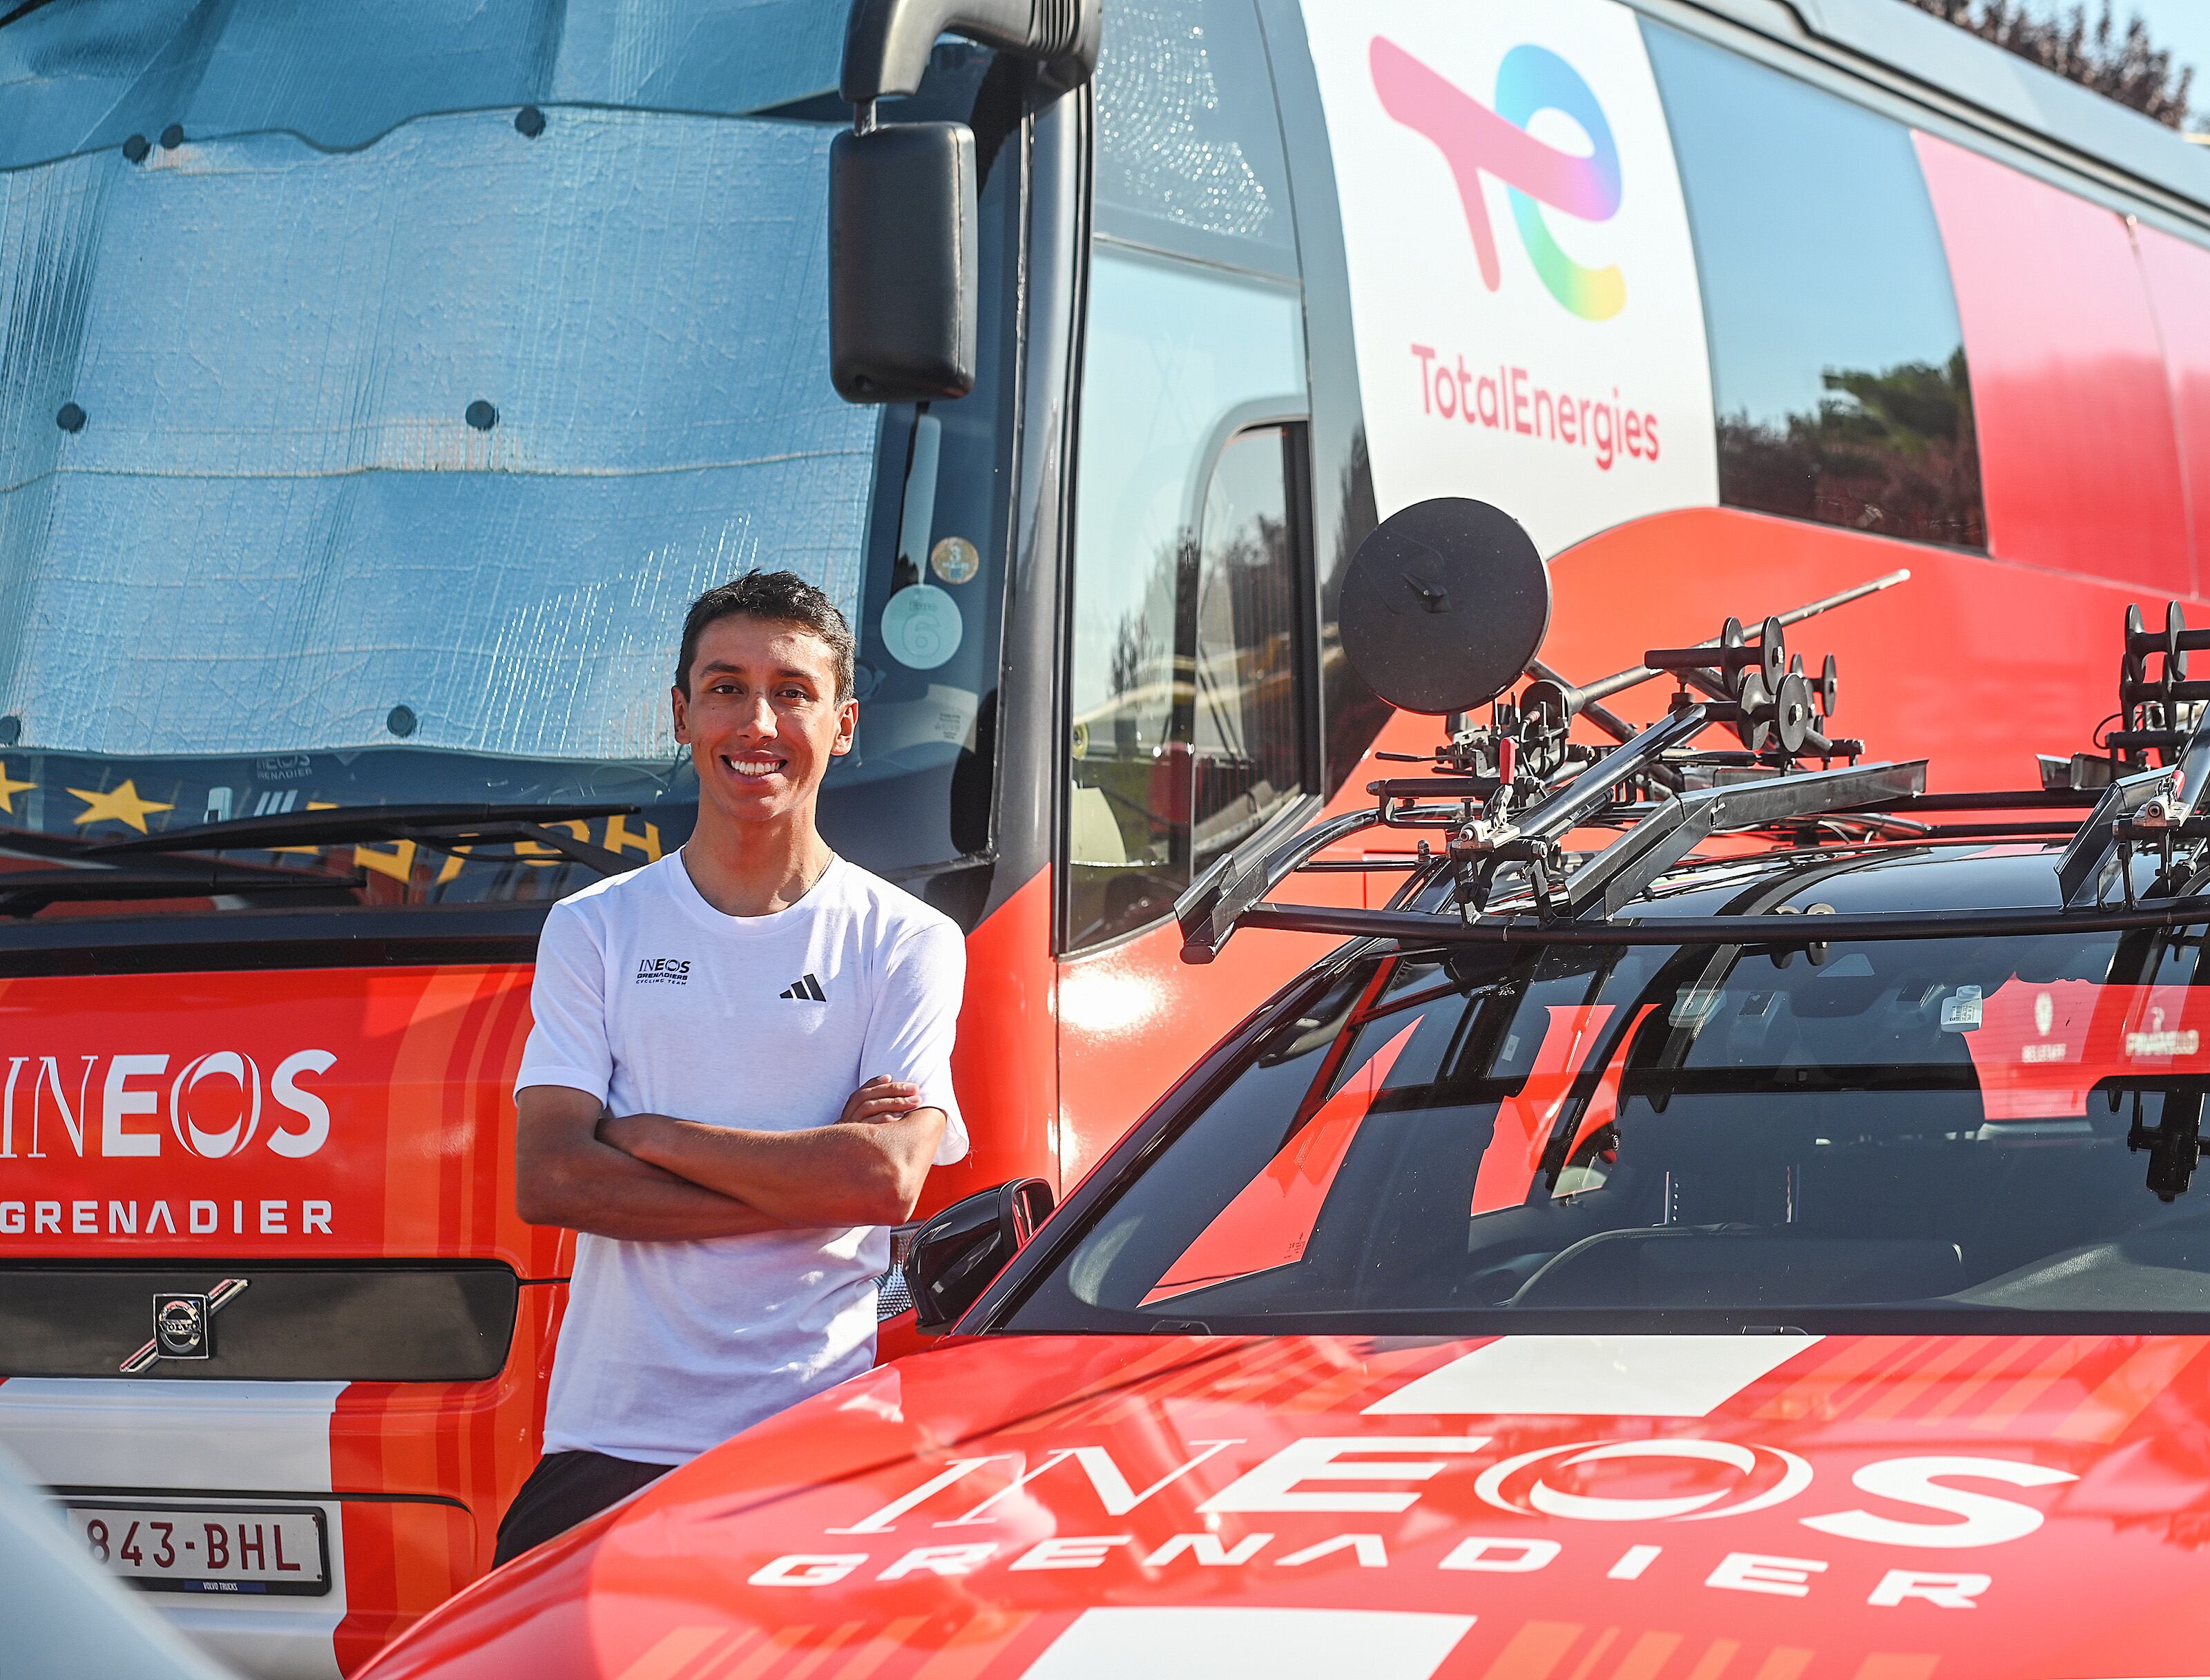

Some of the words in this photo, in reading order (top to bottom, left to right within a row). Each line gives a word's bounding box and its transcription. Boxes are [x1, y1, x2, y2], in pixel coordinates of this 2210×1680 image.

[1410, 343, 1661, 471] TotalEnergies
[639, 958, 691, 973] INEOS
[0, 1049, 338, 1159] INEOS
[0, 1199, 334, 1235] GRENADIER
[825, 1437, 2082, 1548] INEOS
[87, 1518, 301, 1571] 843-BHL
[747, 1532, 1992, 1609] GRENADIER
[202, 1581, 219, 1590] VOLVO
[219, 1582, 238, 1591] TRUCKS
